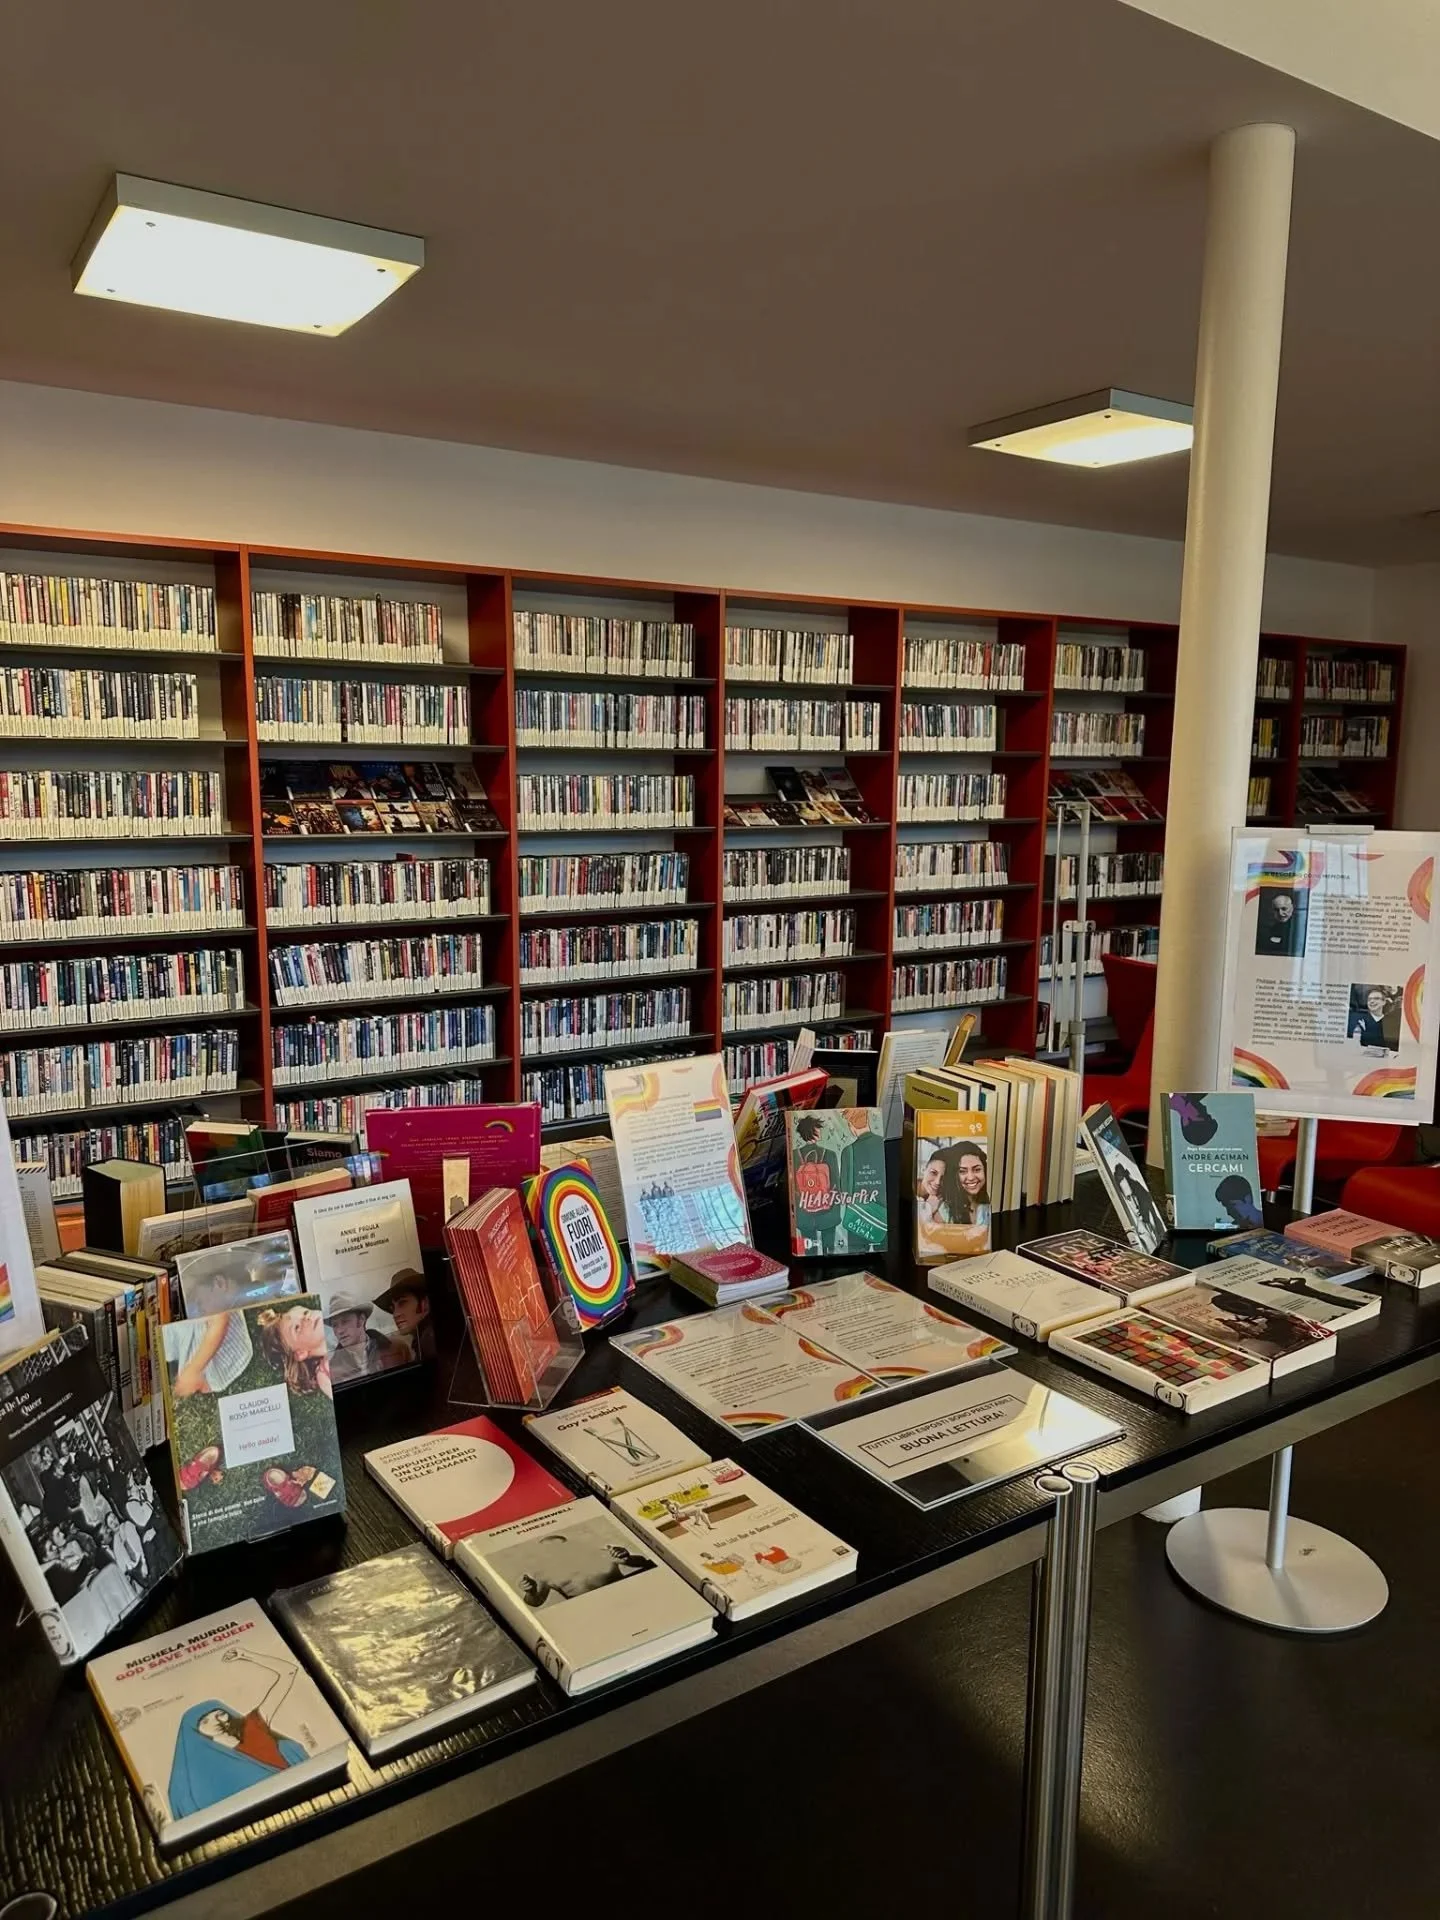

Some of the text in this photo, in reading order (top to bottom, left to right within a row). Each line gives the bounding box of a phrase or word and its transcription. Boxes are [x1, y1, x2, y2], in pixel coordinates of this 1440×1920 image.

[306, 1147, 342, 1159] Siamo
[1214, 1153, 1249, 1161] ACIMAN
[1188, 1163, 1244, 1173] CERCAMI
[798, 1188, 880, 1209] HEARTSTOPPER
[340, 1227, 357, 1237] ANNIE
[350, 1234, 369, 1244] segreti
[369, 1233, 376, 1241] di
[567, 1215, 595, 1242] FUORI
[335, 1237, 390, 1255] Brokeback Mountain
[575, 1232, 604, 1261] NOMI!
[1046, 1238, 1107, 1259] LOVE
[1073, 1247, 1126, 1269] AFTER
[1099, 1258, 1158, 1281] LOVE
[4, 1392, 30, 1413] De Leo
[21, 1397, 42, 1416] Queer
[229, 1403, 281, 1422] ROSSI MARCELLI
[239, 1397, 270, 1410] CLAUDIO
[557, 1420, 580, 1432] Gay
[588, 1404, 628, 1420] lesbiche
[864, 1438, 890, 1451] TUTTI
[894, 1429, 916, 1442] LIBRI
[915, 1418, 950, 1435] ESPOSTI
[949, 1411, 972, 1423] SONO
[899, 1410, 1008, 1452] BUONA LETTURA!
[238, 1435, 280, 1451] Hello daddy!
[379, 1435, 450, 1461] MONIQUE WITTIG
[390, 1446, 460, 1473] APPUNTI PER
[393, 1447, 477, 1479] UN DIZIONARIO
[399, 1454, 478, 1484] DELLE AMANTI
[488, 1505, 574, 1538] GARTH GREENWELL
[516, 1518, 558, 1535] PUREZZA
[115, 1621, 256, 1682] GOD SAVE THE QUEER
[125, 1620, 240, 1670] MICHELA MURGIA
